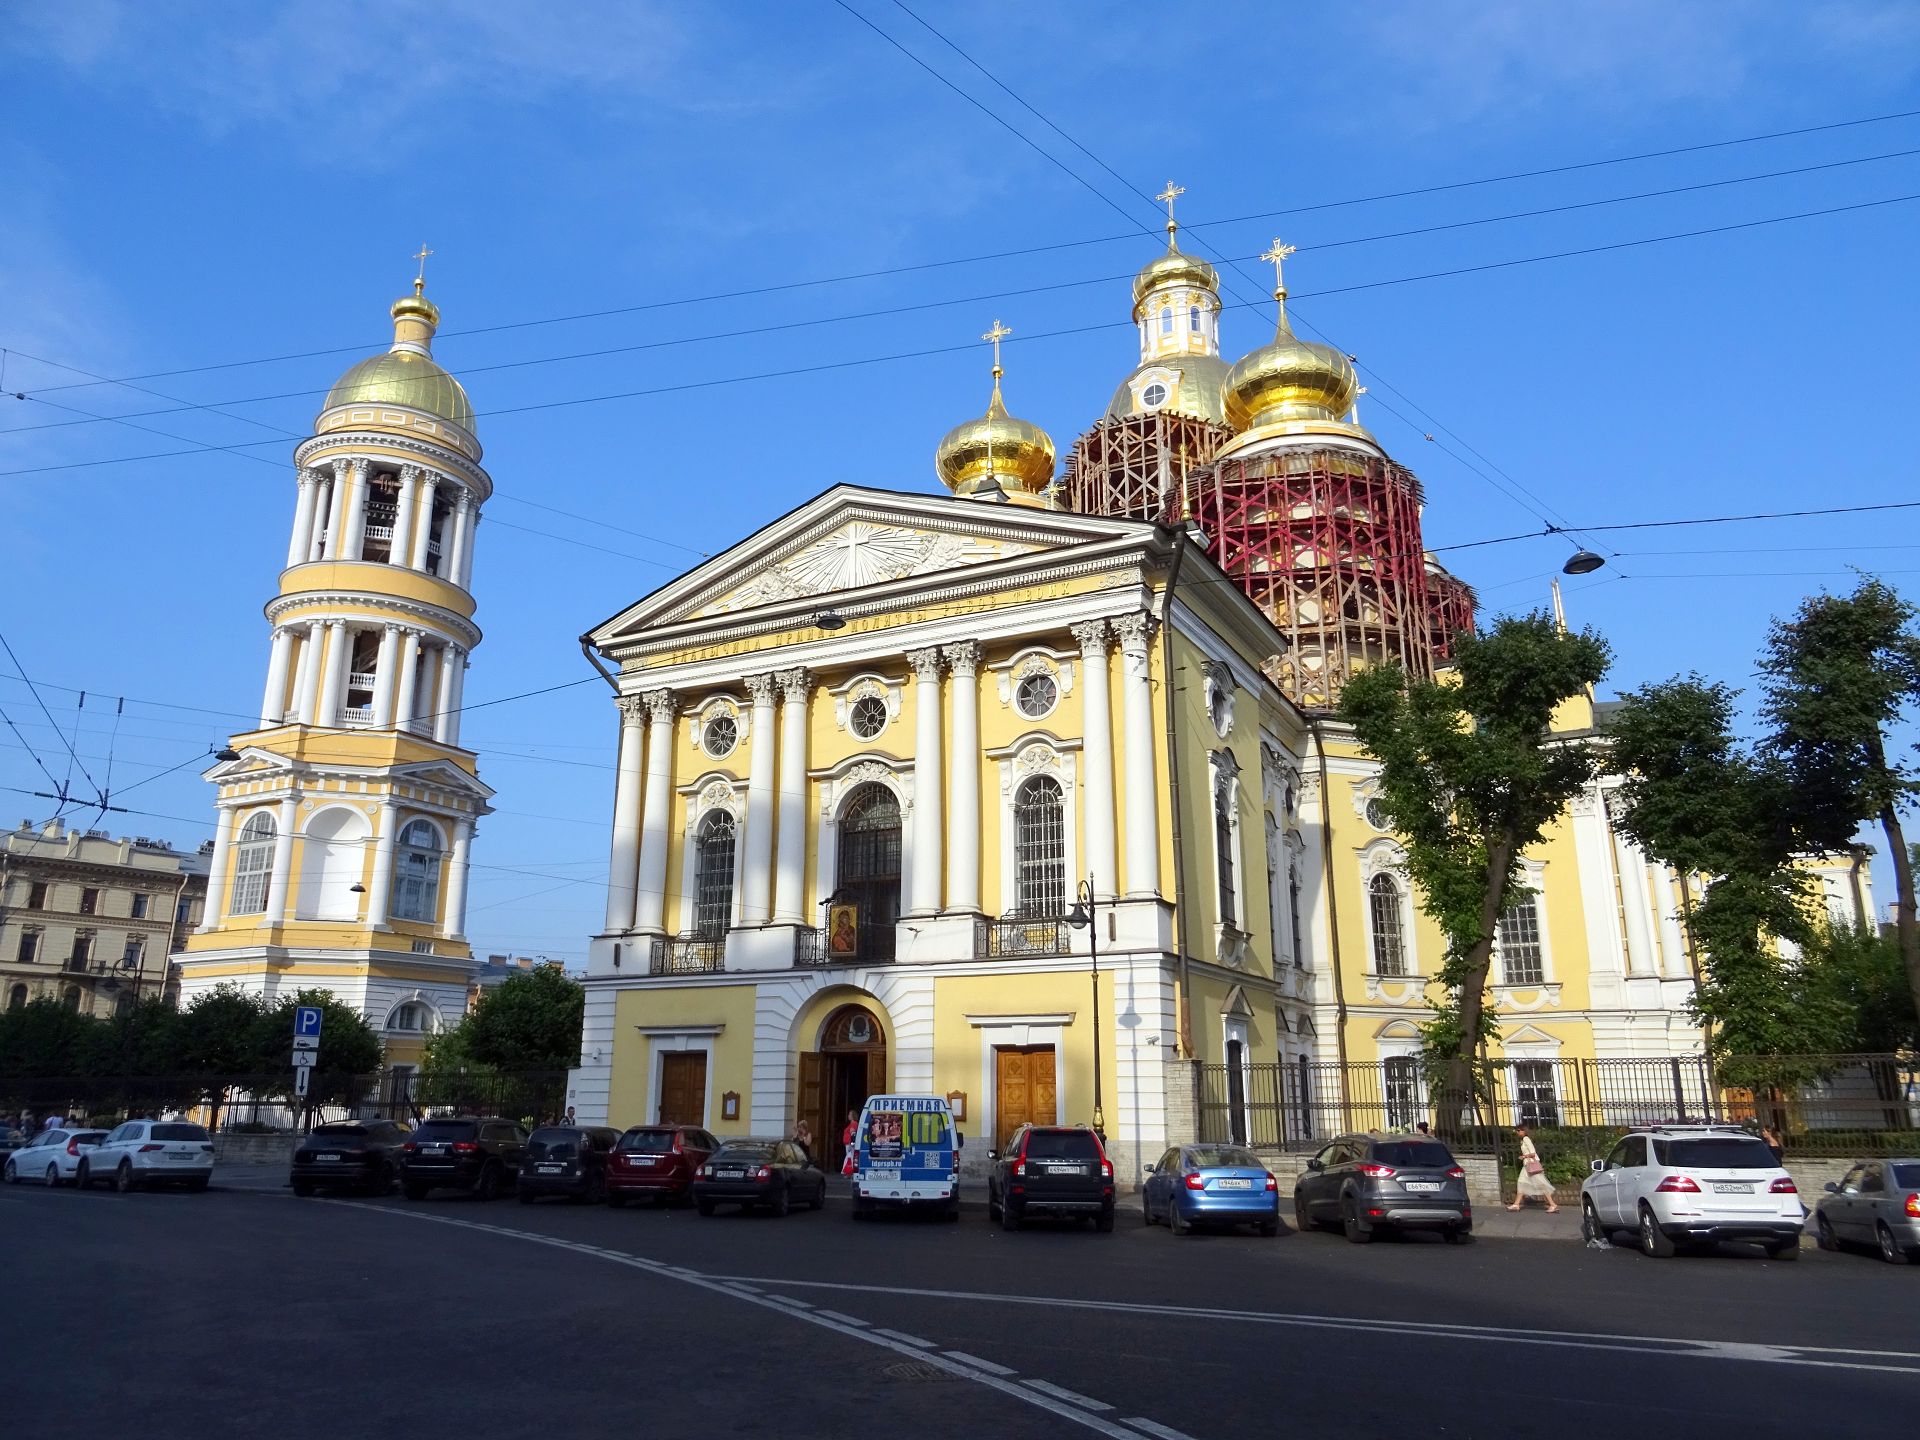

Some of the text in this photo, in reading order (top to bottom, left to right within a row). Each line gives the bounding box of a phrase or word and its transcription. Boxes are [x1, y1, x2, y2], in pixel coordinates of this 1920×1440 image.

[851, 610, 926, 633] МОЛИТВЫ
[943, 596, 996, 616] РАБОВ
[1013, 582, 1070, 602] ТВОИХ
[302, 1010, 317, 1033] P
[875, 1100, 940, 1111] ПРИЕМНАЯ
